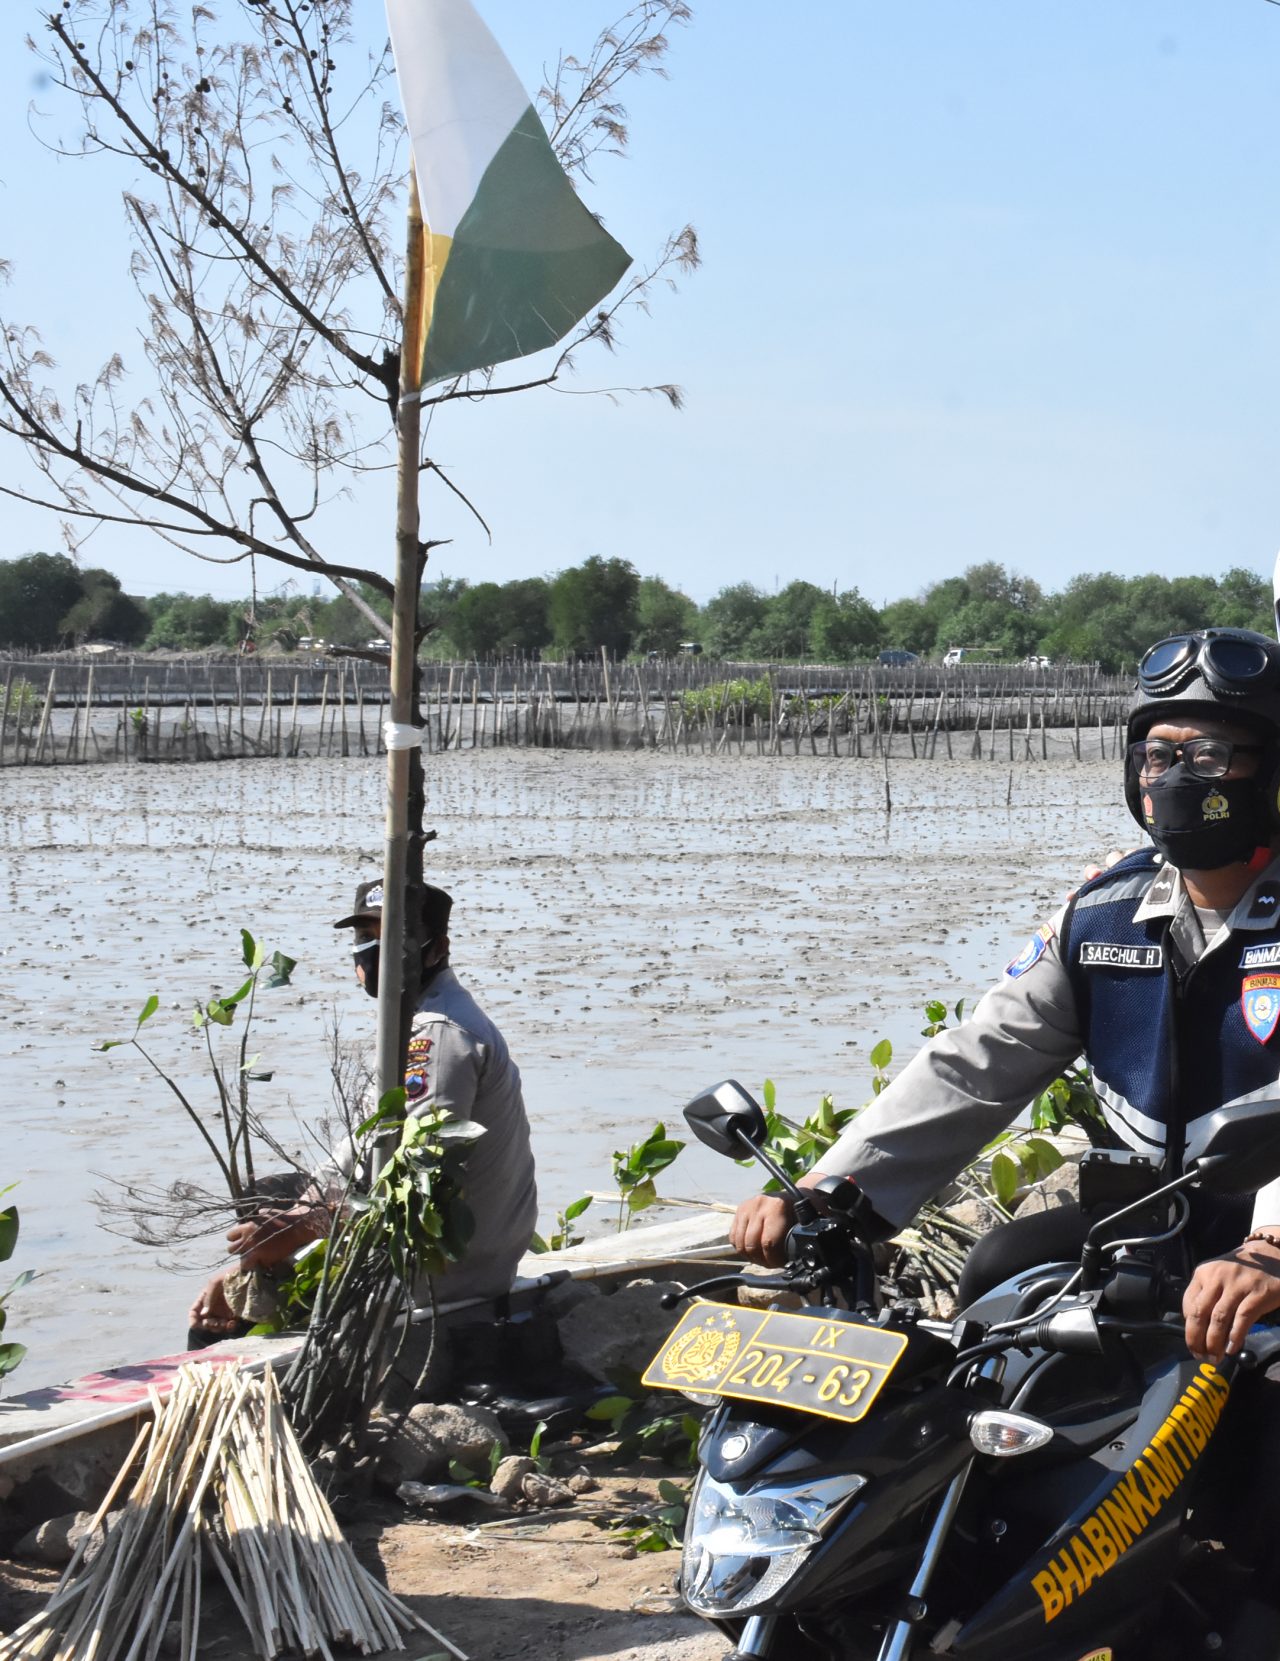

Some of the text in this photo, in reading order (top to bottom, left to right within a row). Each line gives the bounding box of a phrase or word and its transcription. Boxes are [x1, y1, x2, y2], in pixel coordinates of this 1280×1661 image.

[1203, 811, 1230, 821] POLRI
[1087, 946, 1154, 965] SAECHUL H
[1250, 977, 1278, 988] BINMAS
[810, 1325, 846, 1349] IX
[1030, 1362, 1231, 1624] BHABINKAMTIBMAS
